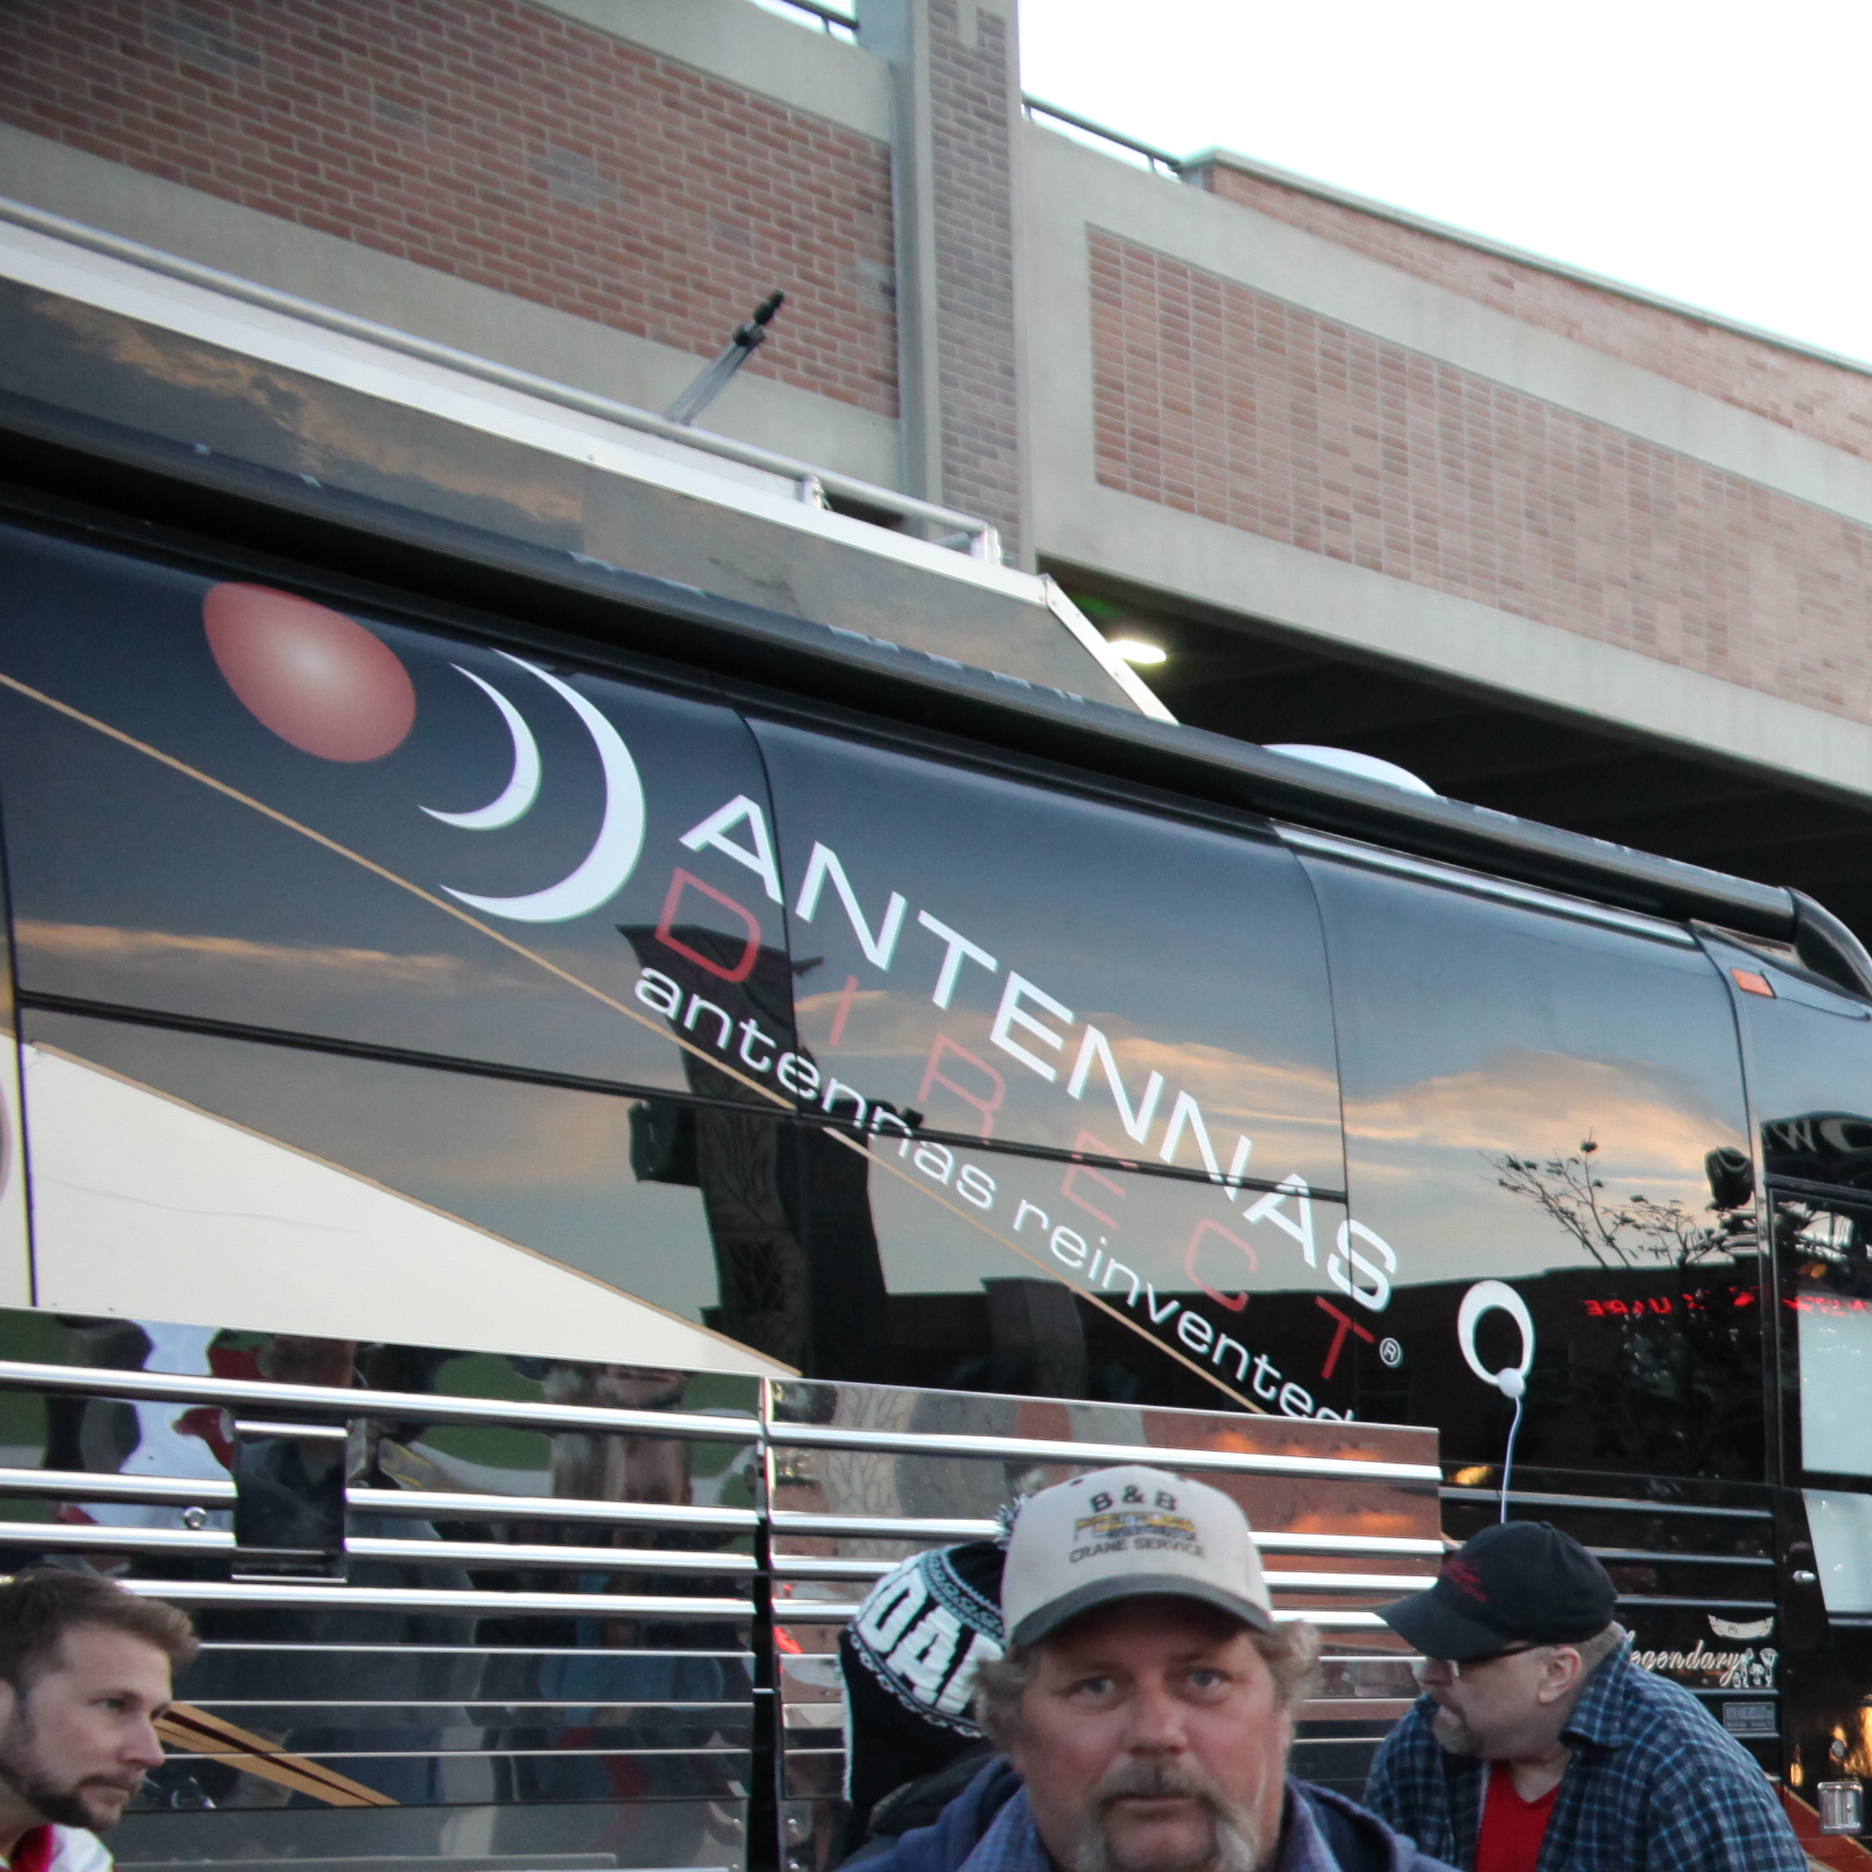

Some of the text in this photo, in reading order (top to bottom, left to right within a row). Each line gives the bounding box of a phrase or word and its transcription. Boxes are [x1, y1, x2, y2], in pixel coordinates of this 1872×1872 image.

[633, 966, 996, 1211] antennas
[653, 867, 1375, 1380] DIRECT
[679, 794, 1397, 1312] ANTENNAS
[1069, 1537, 1206, 1563] CRANE SERVICE
[1090, 1484, 1177, 1512] B & B
[1626, 1629, 1740, 1688] egendary
